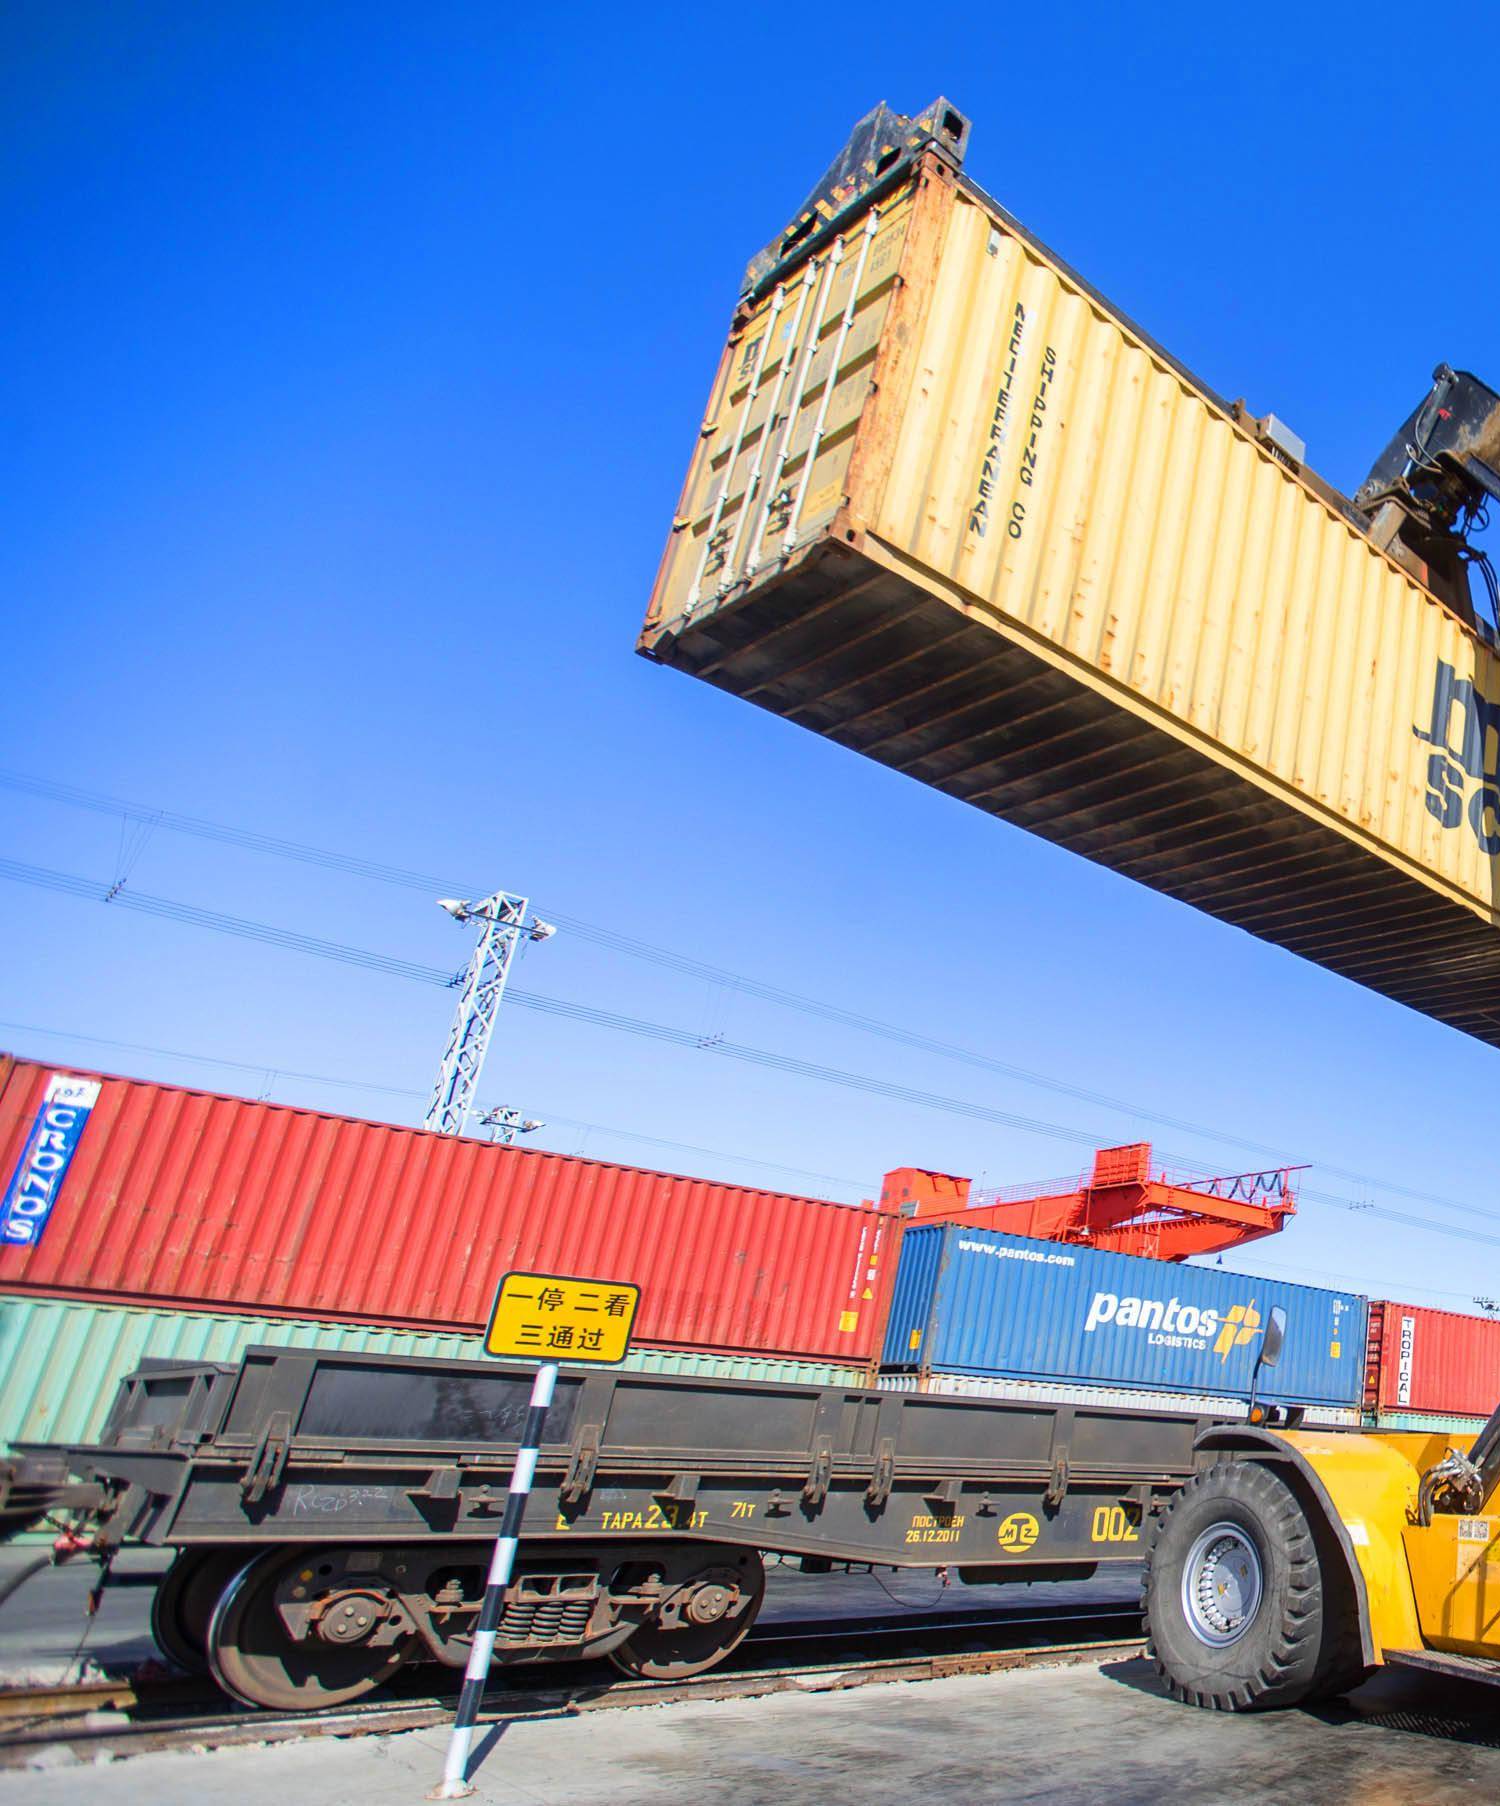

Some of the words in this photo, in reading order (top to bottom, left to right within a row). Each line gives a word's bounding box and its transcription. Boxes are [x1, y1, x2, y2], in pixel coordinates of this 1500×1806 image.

[1018, 346, 1057, 488] SHIPPING
[1008, 502, 1026, 540] CO
[958, 1239, 1076, 1267] www.pantos.com
[1084, 1292, 1218, 1338] pantos
[514, 1324, 605, 1351] 三通过
[1147, 1333, 1206, 1350] LOGISTICS
[1398, 1319, 1412, 1404] TROPICAL
[905, 1530, 960, 1543] 26.12.2011
